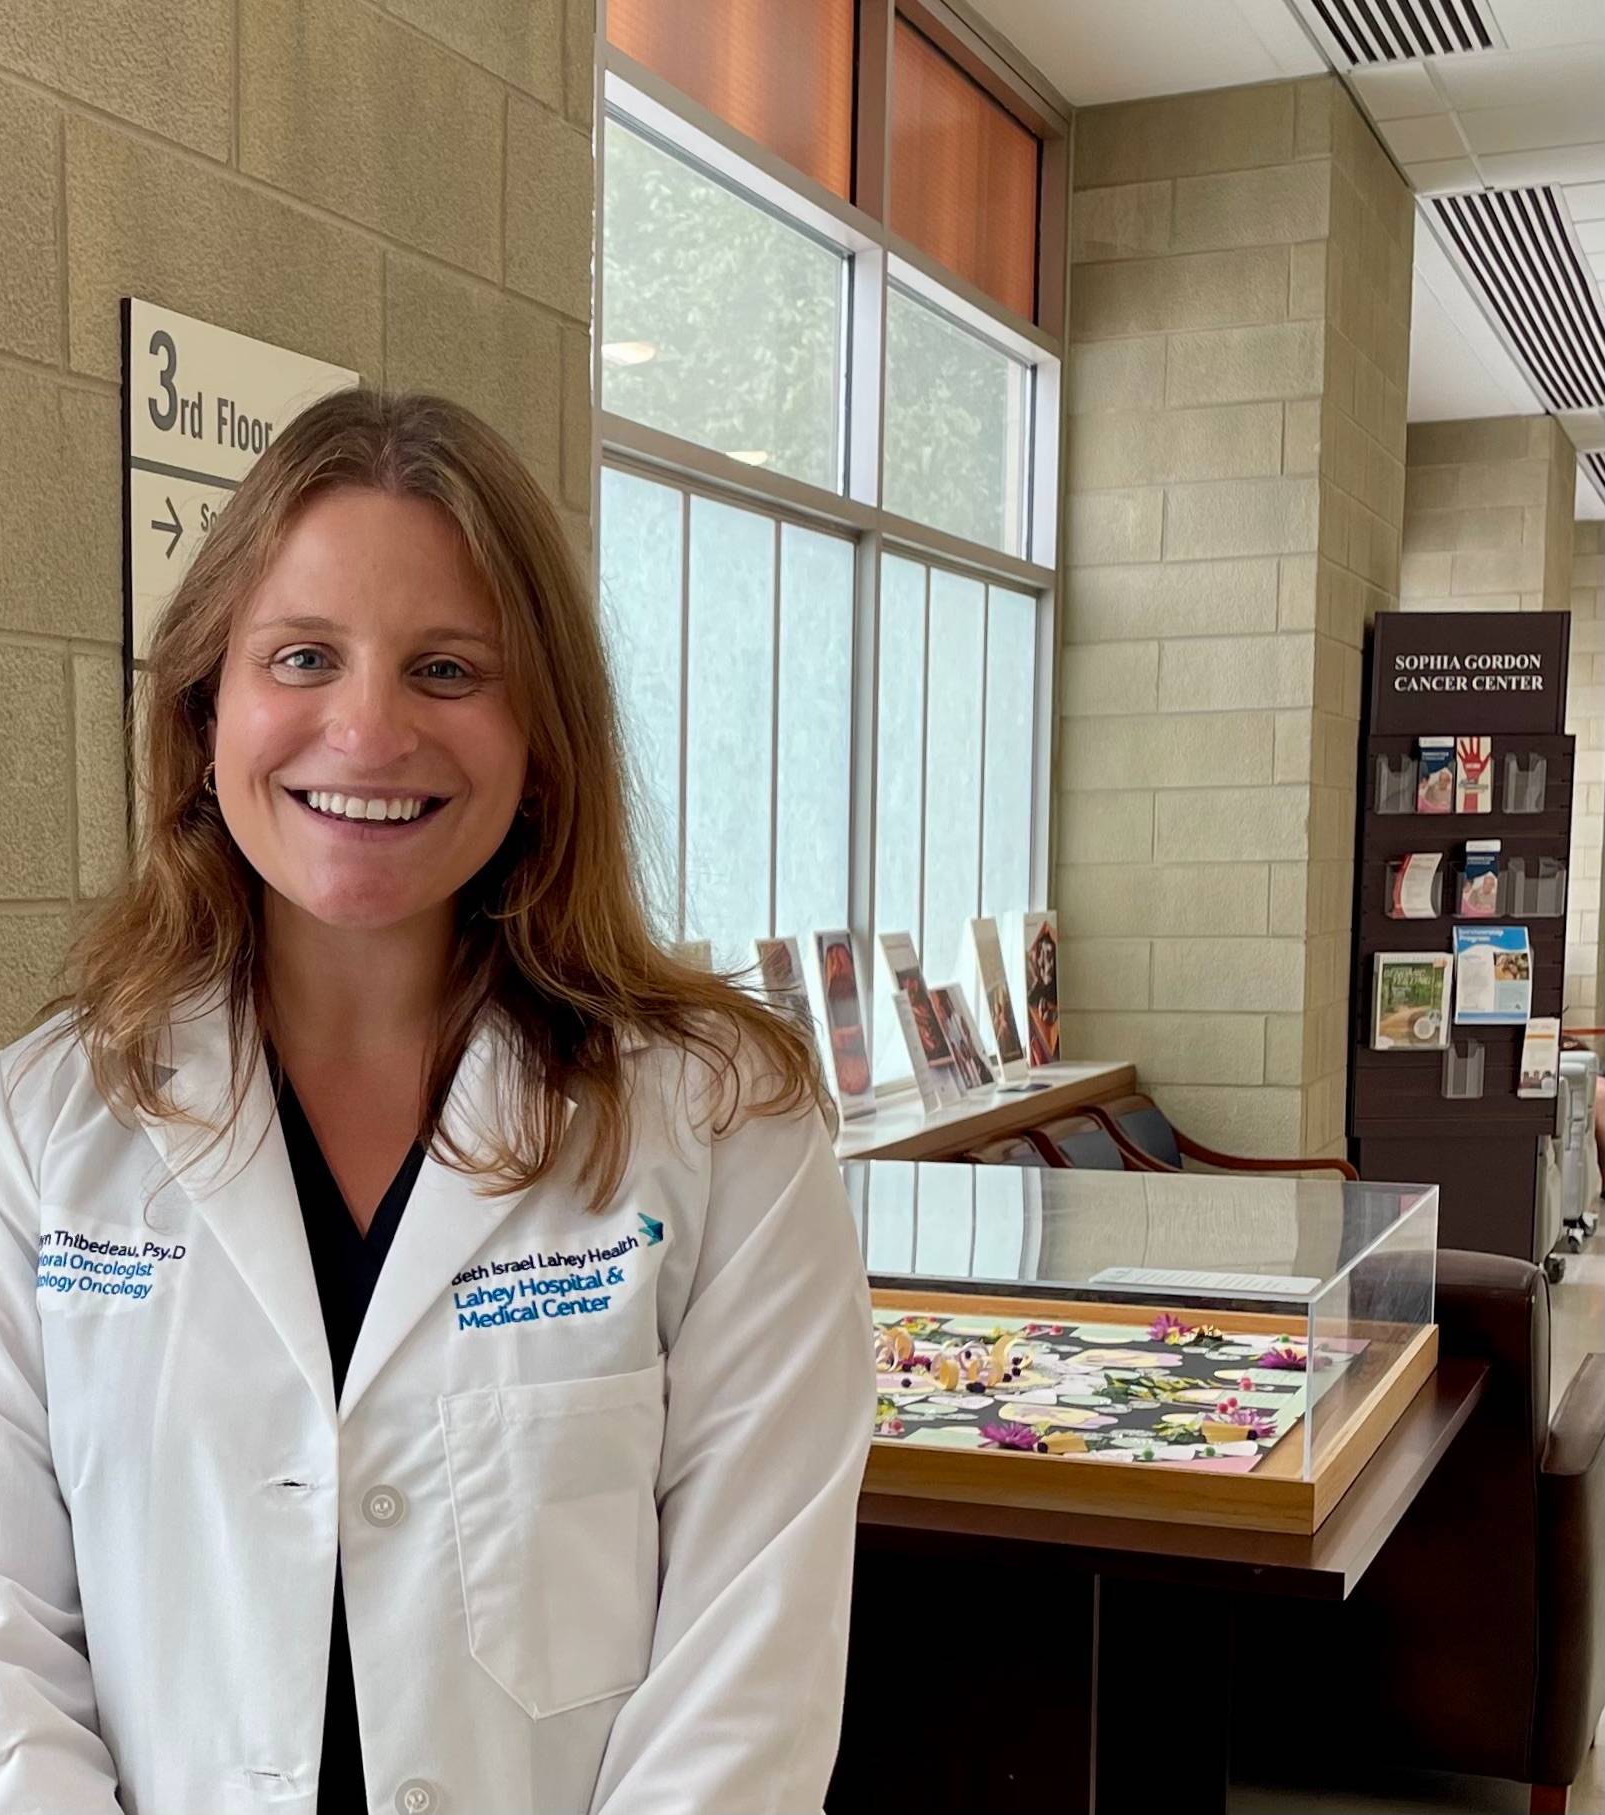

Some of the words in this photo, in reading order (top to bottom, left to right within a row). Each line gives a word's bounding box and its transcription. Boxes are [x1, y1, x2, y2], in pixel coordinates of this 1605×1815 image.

[149, 330, 202, 439] 3rd
[217, 397, 273, 454] Floor
[1395, 655, 1461, 670] SOPHIA
[1465, 654, 1541, 669] GORDON
[1394, 676, 1468, 691] CANCER
[1472, 676, 1543, 690] CENTER
[55, 1230, 139, 1257] Thibedeau,
[143, 1242, 185, 1261] Psy.D
[493, 1256, 535, 1275] Israel
[540, 1252, 585, 1269] Lahey
[589, 1236, 638, 1263] Health
[70, 1255, 153, 1278] Oncologist
[79, 1277, 152, 1298] Oncology
[454, 1284, 514, 1309] Lahey
[520, 1270, 603, 1297] Hospital
[606, 1266, 625, 1285] &
[459, 1301, 539, 1330] Medical
[543, 1295, 611, 1318] Center
